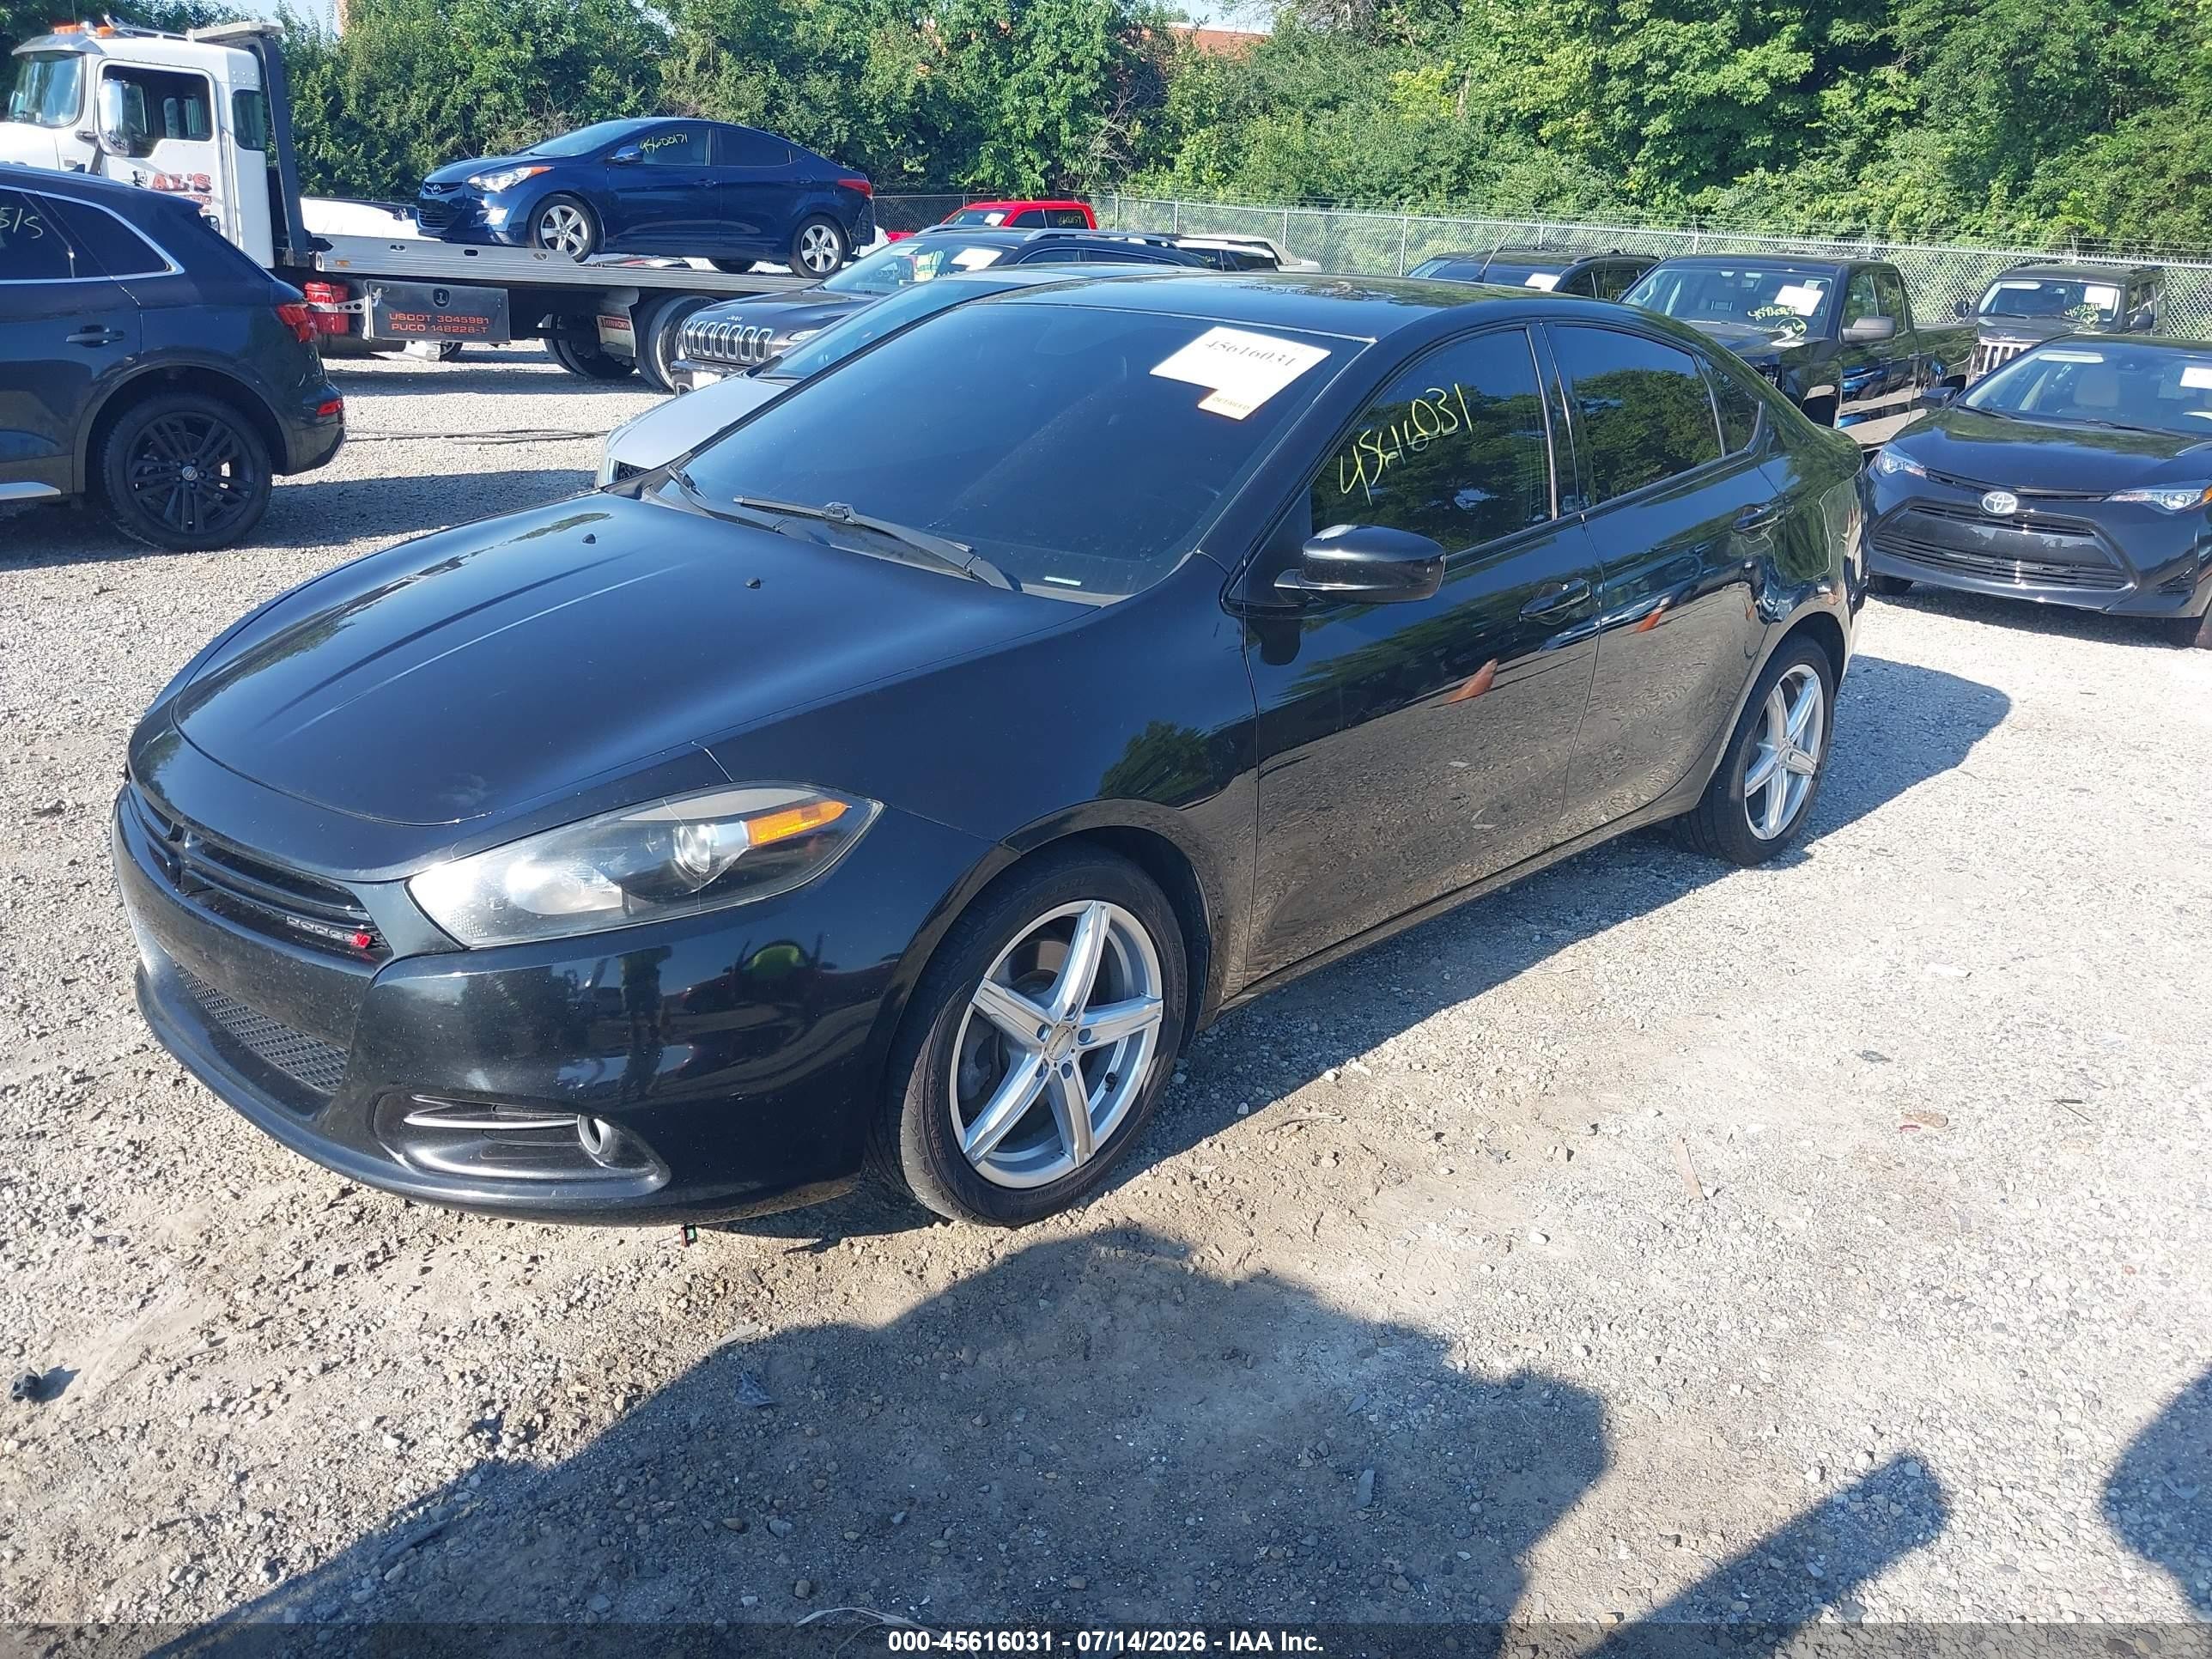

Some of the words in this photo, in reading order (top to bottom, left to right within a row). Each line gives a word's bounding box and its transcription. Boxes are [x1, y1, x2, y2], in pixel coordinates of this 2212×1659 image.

[388, 313, 433, 322] USDOT
[391, 323, 426, 331] PUCO
[286, 915, 357, 944] DODGE
